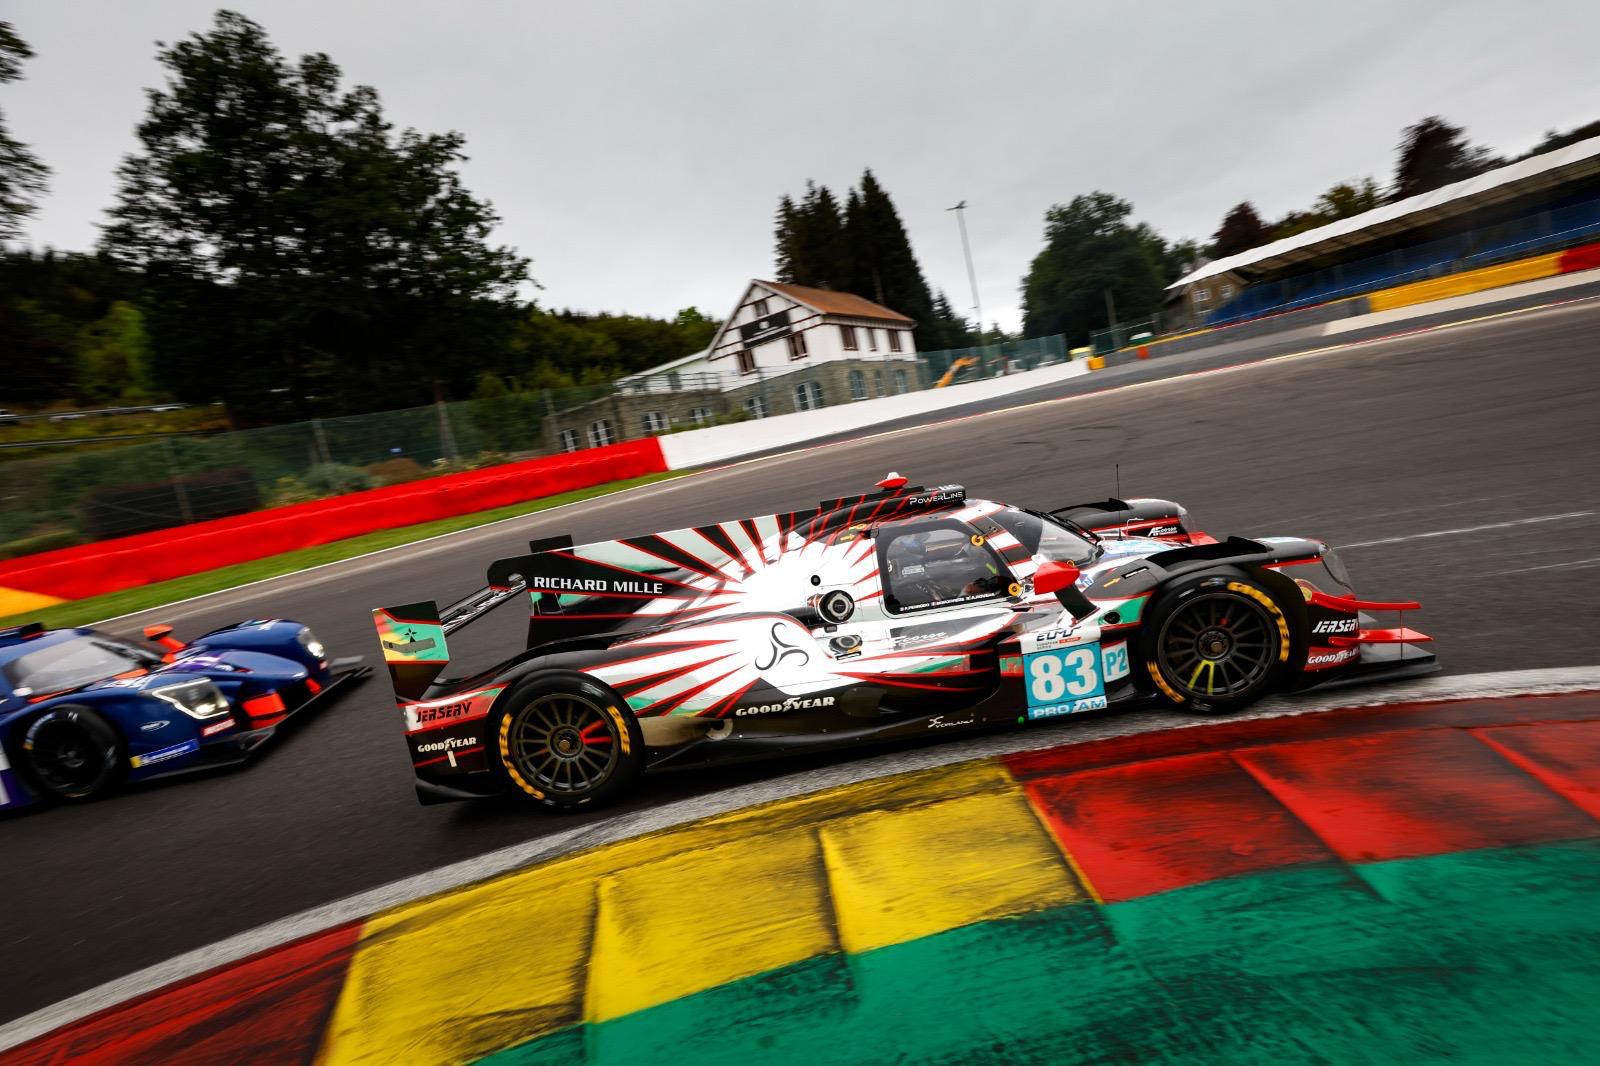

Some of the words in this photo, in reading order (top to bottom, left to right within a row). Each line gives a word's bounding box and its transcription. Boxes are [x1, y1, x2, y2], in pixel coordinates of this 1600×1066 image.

[534, 576, 607, 591] RICHARD
[613, 581, 663, 594] MILLE
[1105, 648, 1128, 676] P2
[1030, 648, 1098, 701] 83
[735, 696, 836, 716] GOODYEAR
[417, 736, 477, 753] GOODYEAR
